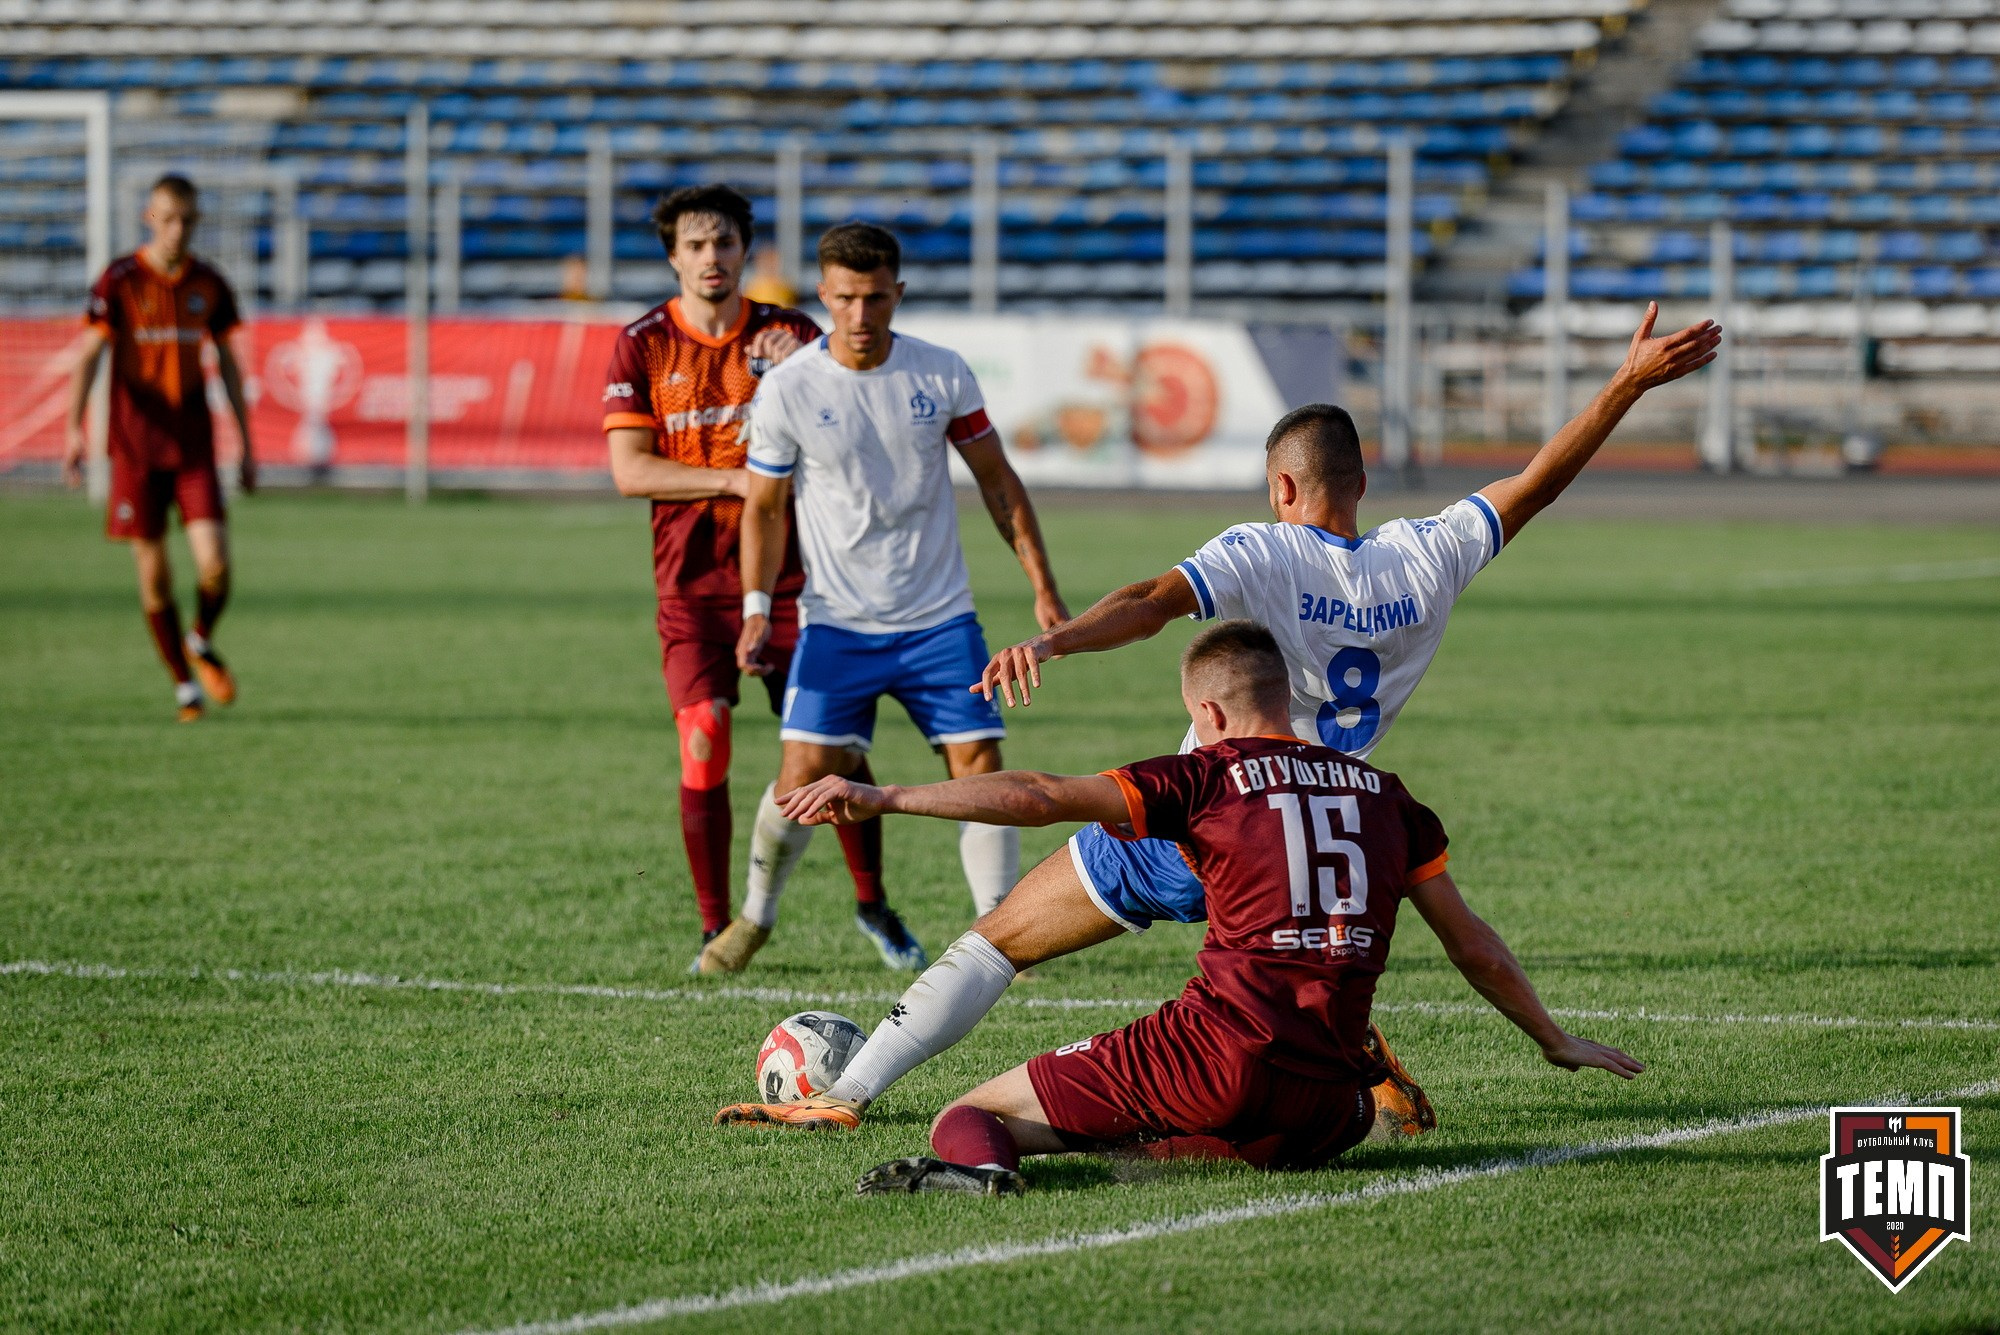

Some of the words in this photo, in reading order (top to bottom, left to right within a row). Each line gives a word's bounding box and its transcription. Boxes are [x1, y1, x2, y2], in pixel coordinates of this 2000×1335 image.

[1298, 592, 1419, 637] ЗАРЕЦКИЙ
[1315, 646, 1381, 753] 8
[1229, 755, 1382, 796] ЕВТУШЕНКО
[1266, 793, 1369, 917] 15
